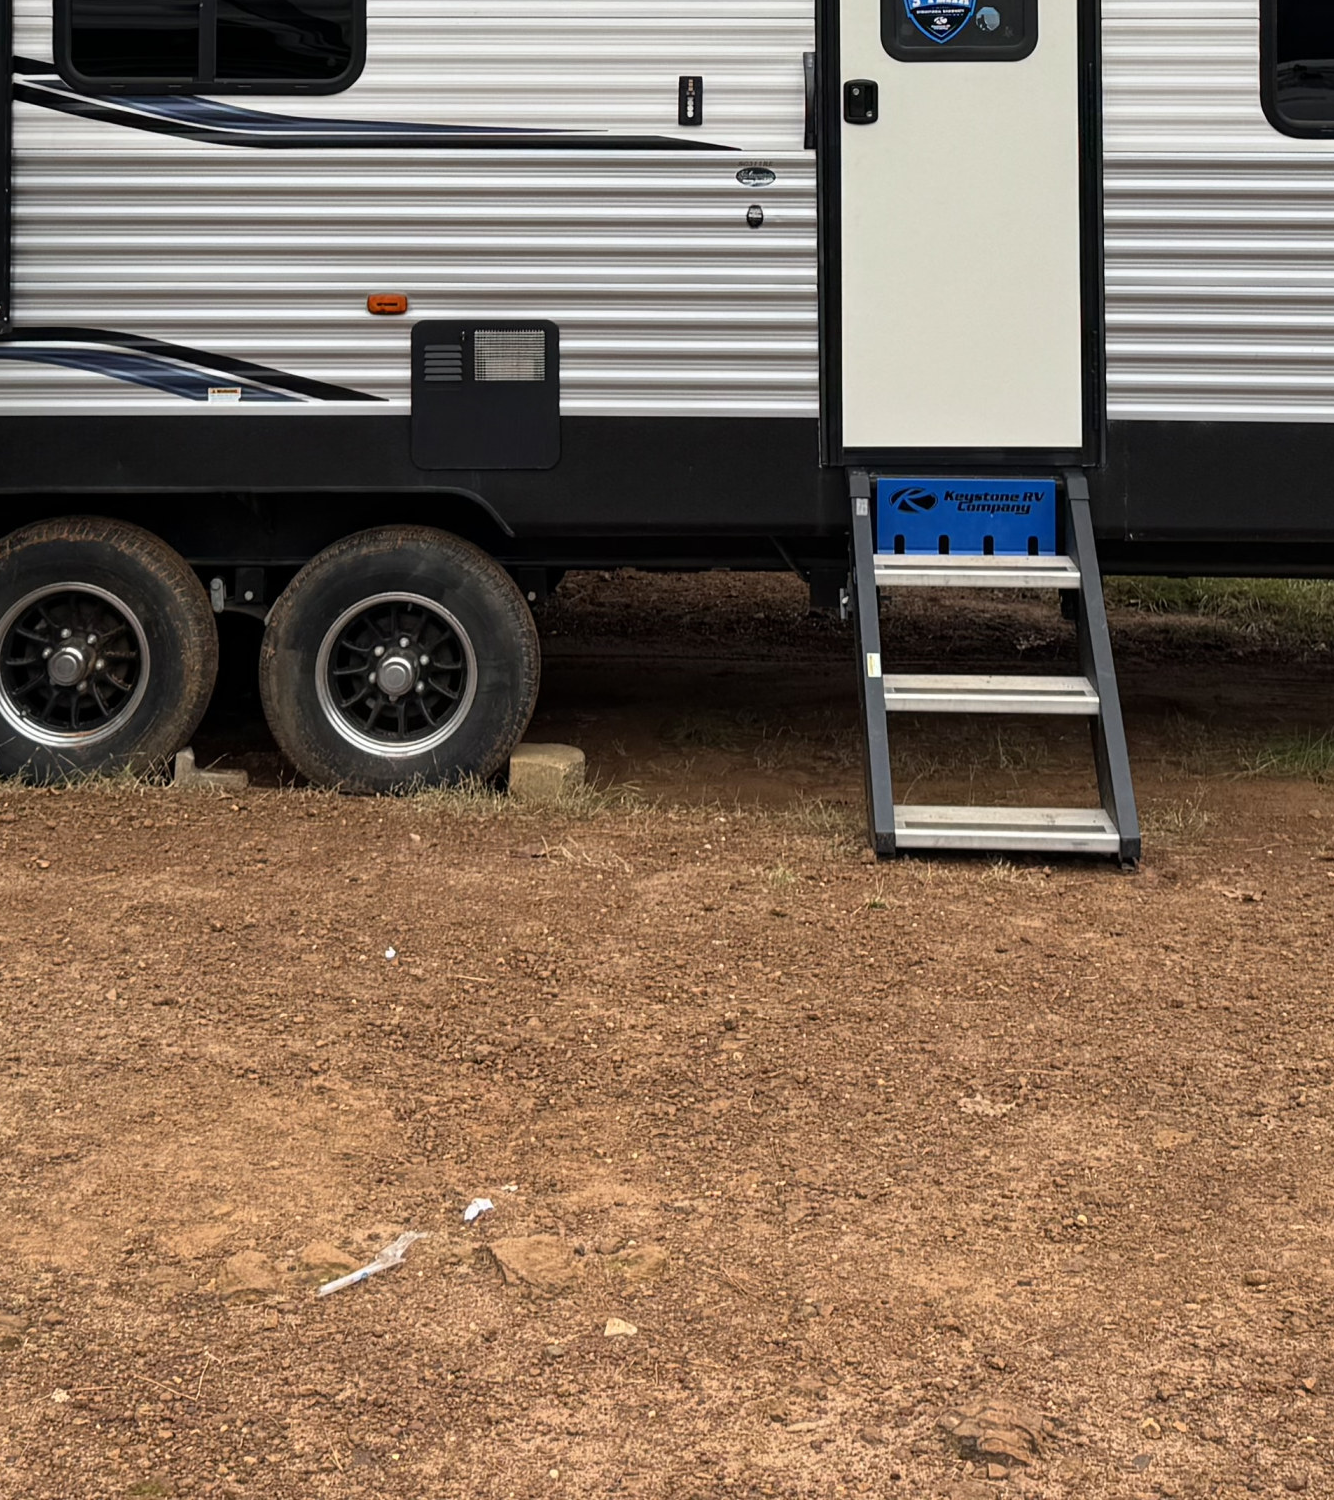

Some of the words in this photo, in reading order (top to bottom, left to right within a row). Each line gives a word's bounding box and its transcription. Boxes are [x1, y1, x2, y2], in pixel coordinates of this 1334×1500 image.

[943, 490, 1020, 502] Keystone
[1022, 490, 1045, 502] RV
[956, 501, 1032, 515] Company
